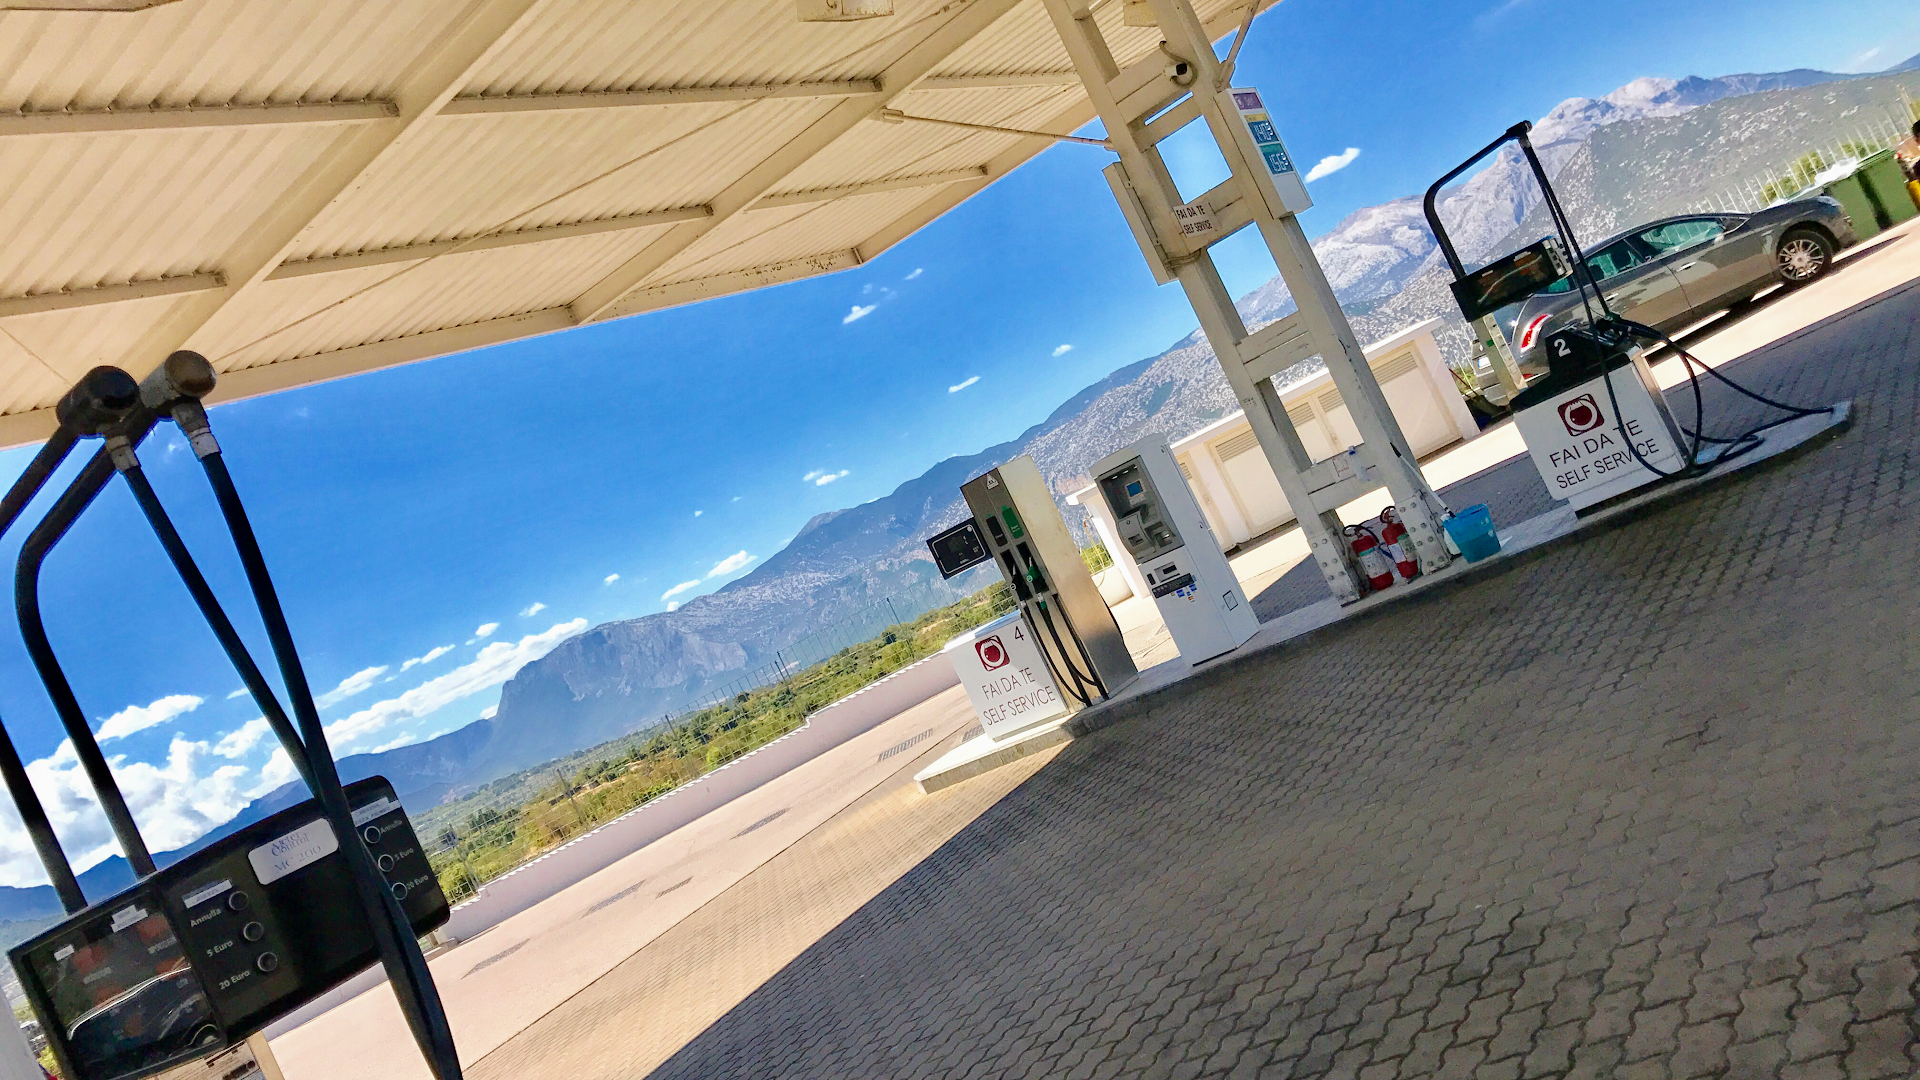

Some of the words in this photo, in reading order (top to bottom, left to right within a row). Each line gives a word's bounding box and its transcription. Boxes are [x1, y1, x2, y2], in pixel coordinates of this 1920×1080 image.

[1176, 209, 1188, 220] FAI
[1186, 207, 1198, 218] DA
[1196, 205, 1206, 216] TE
[1183, 223, 1195, 234] SELF
[1194, 219, 1213, 232] SERVICE
[1554, 338, 1571, 358] 2
[1549, 445, 1581, 468] FAI
[1583, 433, 1615, 454] DA
[1556, 464, 1591, 489] SELF
[1594, 438, 1659, 474] SERVCE
[1014, 625, 1024, 641] 4
[981, 680, 1002, 701] FAI
[1000, 674, 1022, 693] DA
[1018, 667, 1036, 685] TE
[983, 704, 1007, 726] SELF
[1007, 685, 1056, 716] SERVICE
[299, 845, 321, 862] 200
[400, 847, 414, 858] Euro
[407, 881, 415, 890] 20
[415, 874, 429, 886] Euro
[190, 908, 221, 928] Annulla
[206, 949, 213, 958] 5
[213, 940, 234, 954] Euro
[219, 980, 230, 990] 20
[231, 970, 251, 984] Euro
